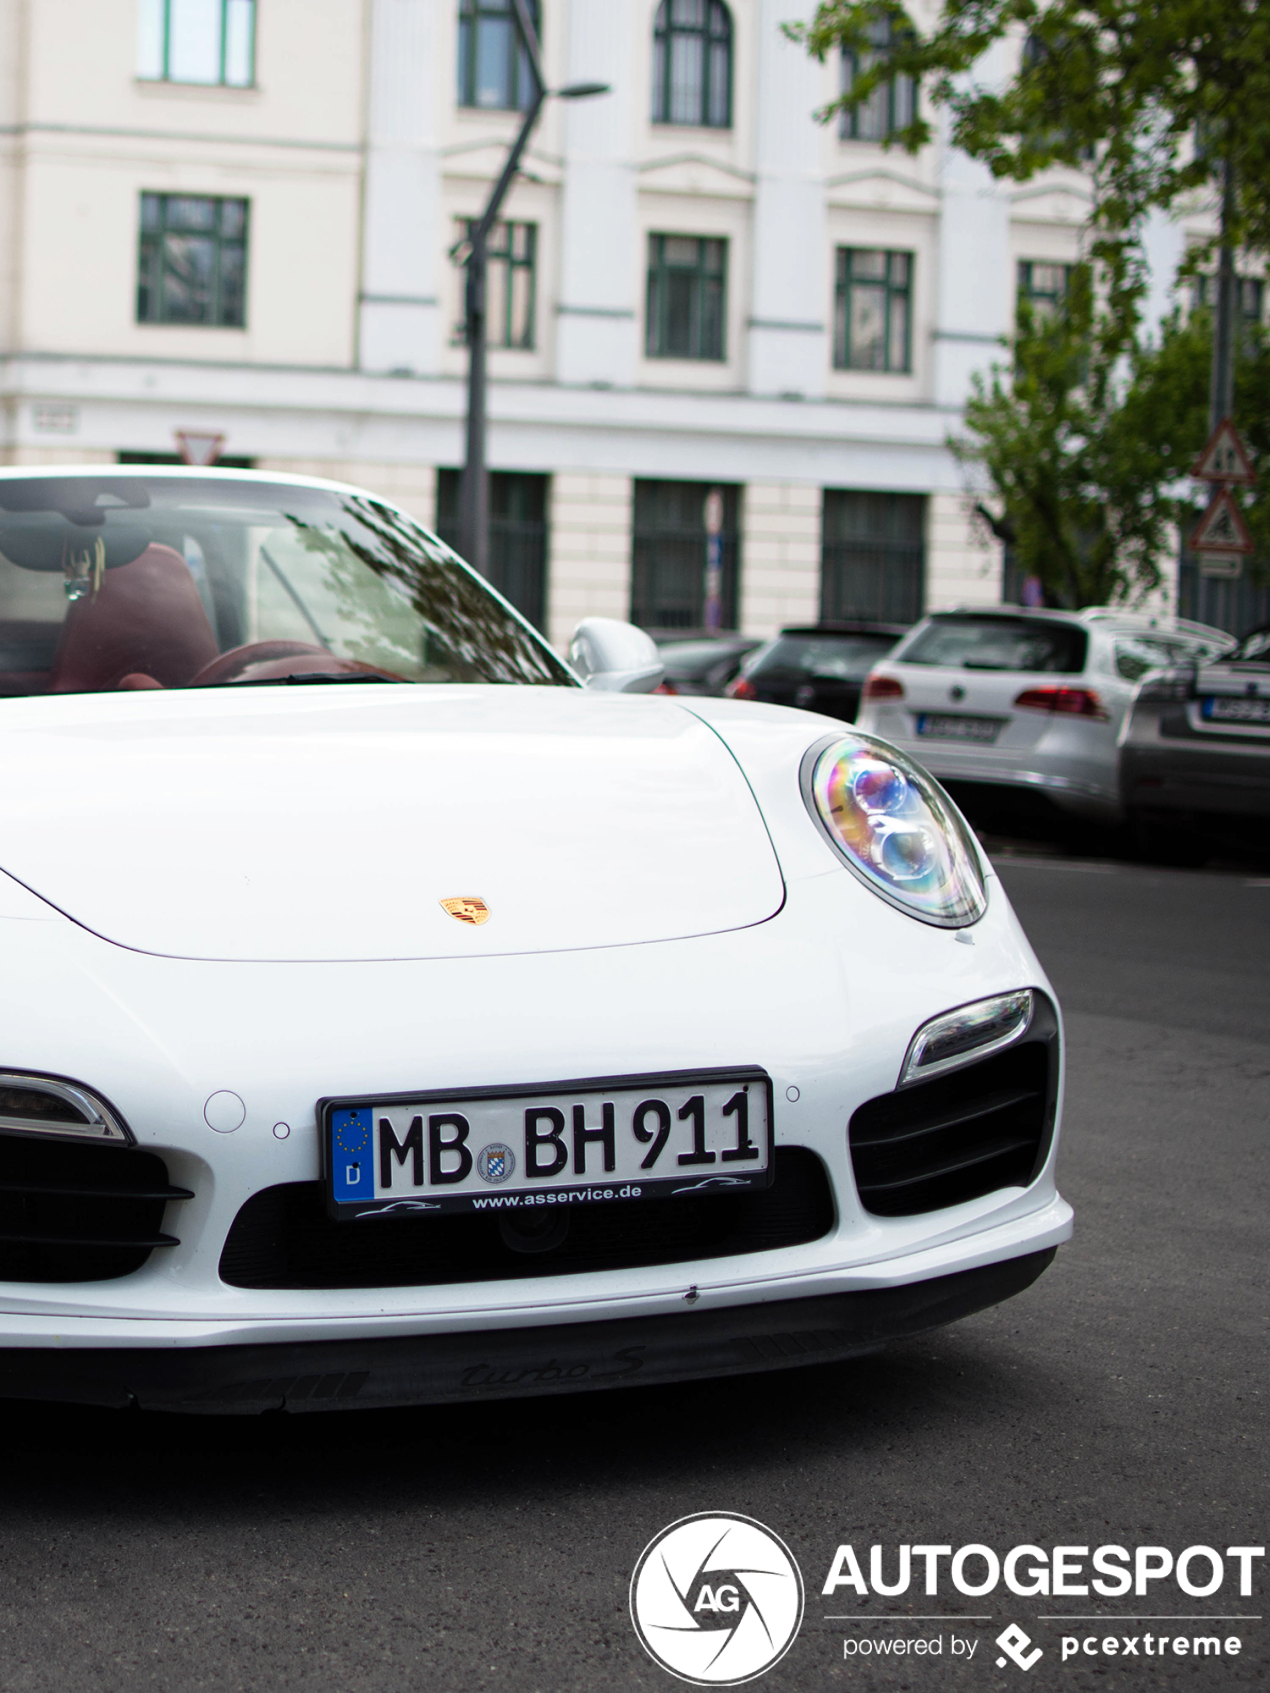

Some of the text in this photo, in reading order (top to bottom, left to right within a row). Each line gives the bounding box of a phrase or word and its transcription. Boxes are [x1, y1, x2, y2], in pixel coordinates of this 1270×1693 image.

[379, 1113, 473, 1189] MB
[525, 1102, 616, 1179] BH
[633, 1091, 760, 1169] 911
[345, 1165, 361, 1186] D
[472, 1184, 642, 1209] www.asservice.de
